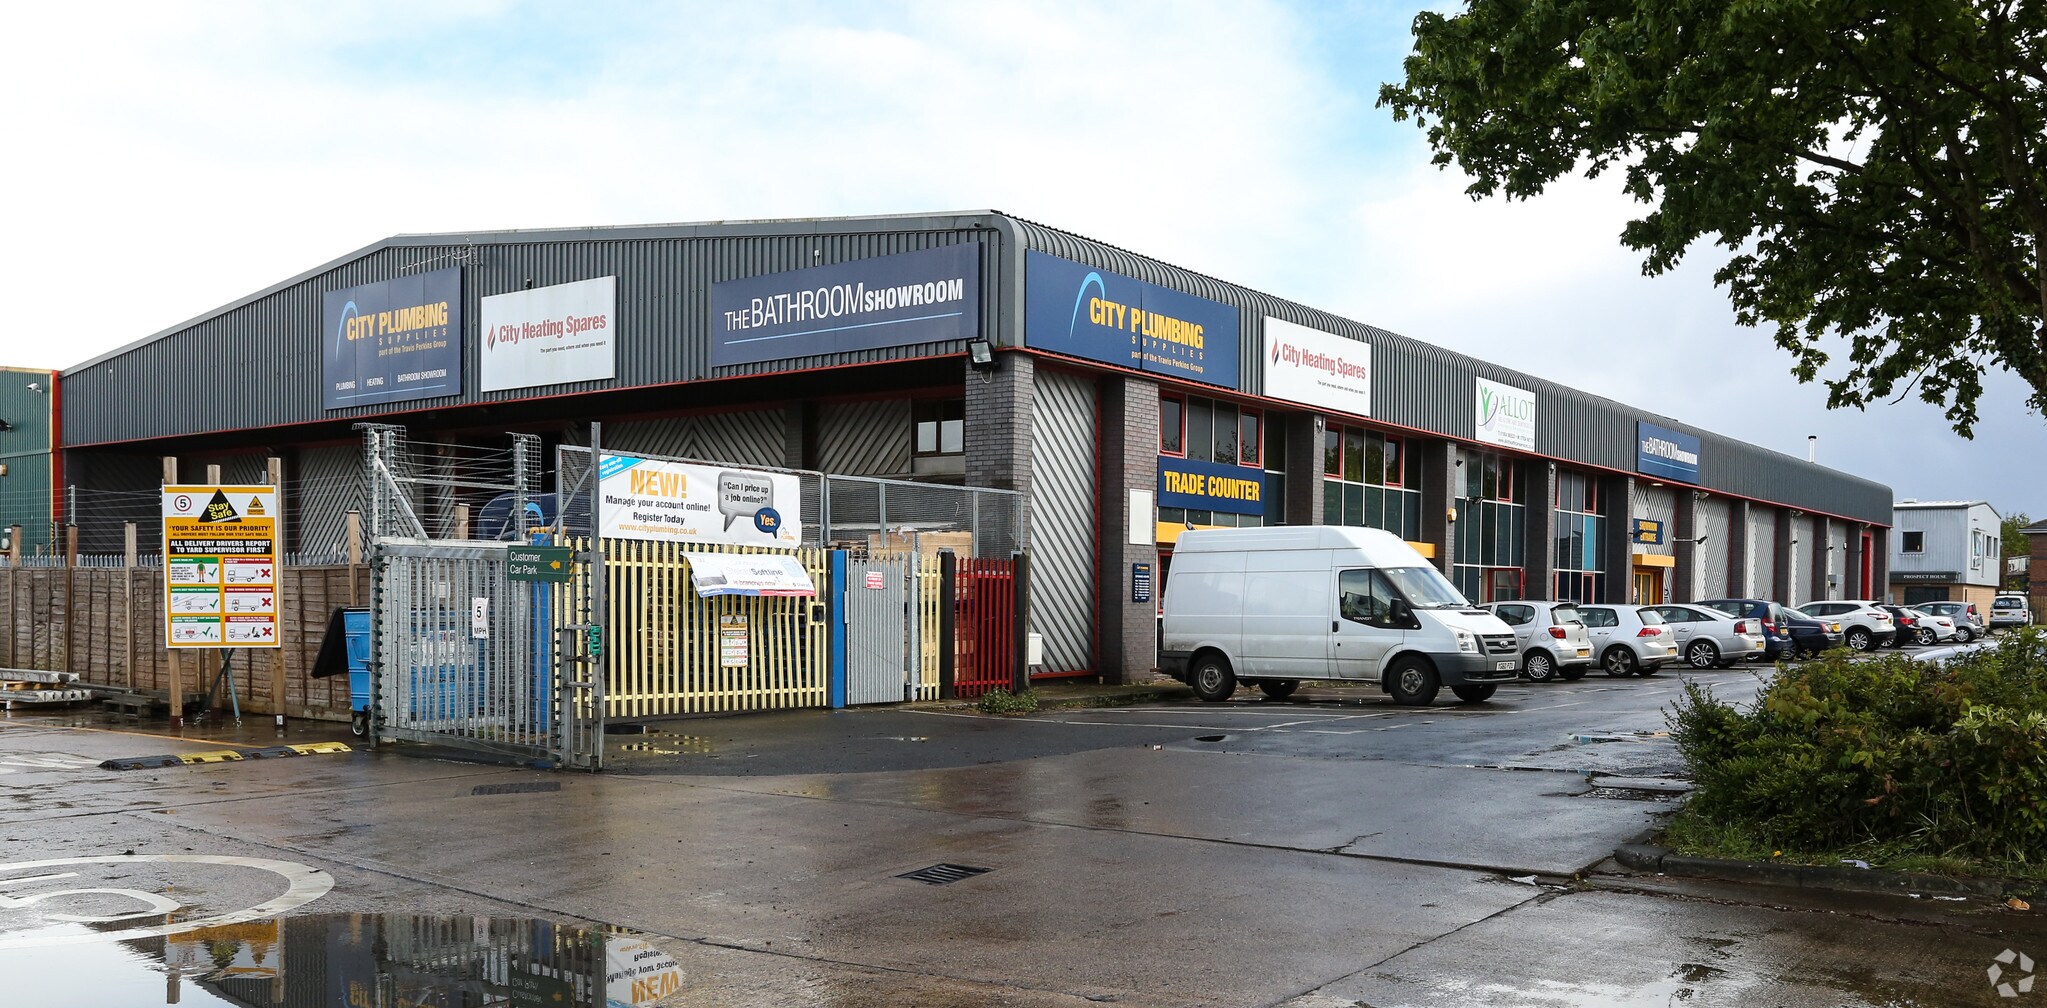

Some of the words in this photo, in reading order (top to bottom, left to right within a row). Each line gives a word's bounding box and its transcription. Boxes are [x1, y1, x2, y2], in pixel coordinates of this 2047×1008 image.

[724, 308, 750, 331] THE
[751, 282, 863, 328] BATHROOM
[864, 278, 963, 312] SHOWROOM
[346, 314, 376, 341] CITY
[378, 301, 448, 336] PLUMBING
[499, 325, 520, 345] City
[522, 319, 564, 339] Heating
[566, 314, 606, 336] Spares
[1089, 297, 1126, 330] CITY
[1131, 307, 1204, 349] PLUMBING
[378, 327, 447, 346] SUPPLIES
[378, 348, 388, 357] part
[388, 347, 394, 355] of
[402, 344, 415, 353] Travis
[415, 342, 432, 351] Perkins
[433, 340, 447, 348] Group
[1131, 335, 1203, 360] SUPPLIES
[1131, 350, 1142, 359] part
[1143, 352, 1149, 360] of
[1149, 353, 1158, 363] the
[1158, 355, 1172, 366] Travis
[1172, 358, 1189, 370] Perkins
[1190, 361, 1204, 374] Group
[1282, 343, 1301, 368] City
[1302, 348, 1336, 376] Heating
[1337, 357, 1366, 380] Spares
[336, 380, 355, 391] PLUMBING
[366, 377, 384, 387] HEATING
[397, 372, 420, 383] BATHROOM
[420, 369, 446, 380] SHOWROOM
[1498, 394, 1535, 422] ALLOT
[1649, 437, 1677, 460] BATHROOM
[630, 468, 687, 499] NEW!
[723, 482, 740, 490] "Can
[745, 484, 760, 493] price
[1163, 470, 1205, 496] TRADE
[1207, 475, 1260, 502] COUNTER
[179, 499, 187, 508] 5
[605, 495, 636, 507] Manage
[638, 499, 654, 508] your
[655, 501, 684, 510] account
[686, 502, 711, 512] online!
[730, 494, 741, 502] job
[208, 502, 229, 513] Stay
[211, 509, 233, 520] Safe
[633, 512, 663, 523] Register
[664, 514, 685, 525] Today
[760, 514, 776, 526] Yes.
[618, 523, 697, 535] www.cityplumbing.co.uk
[510, 551, 541, 562] Customer
[510, 564, 521, 574] Car
[522, 564, 538, 575] Park
[751, 568, 784, 576] Softline
[476, 606, 482, 618] 5
[474, 627, 487, 635] MPH
